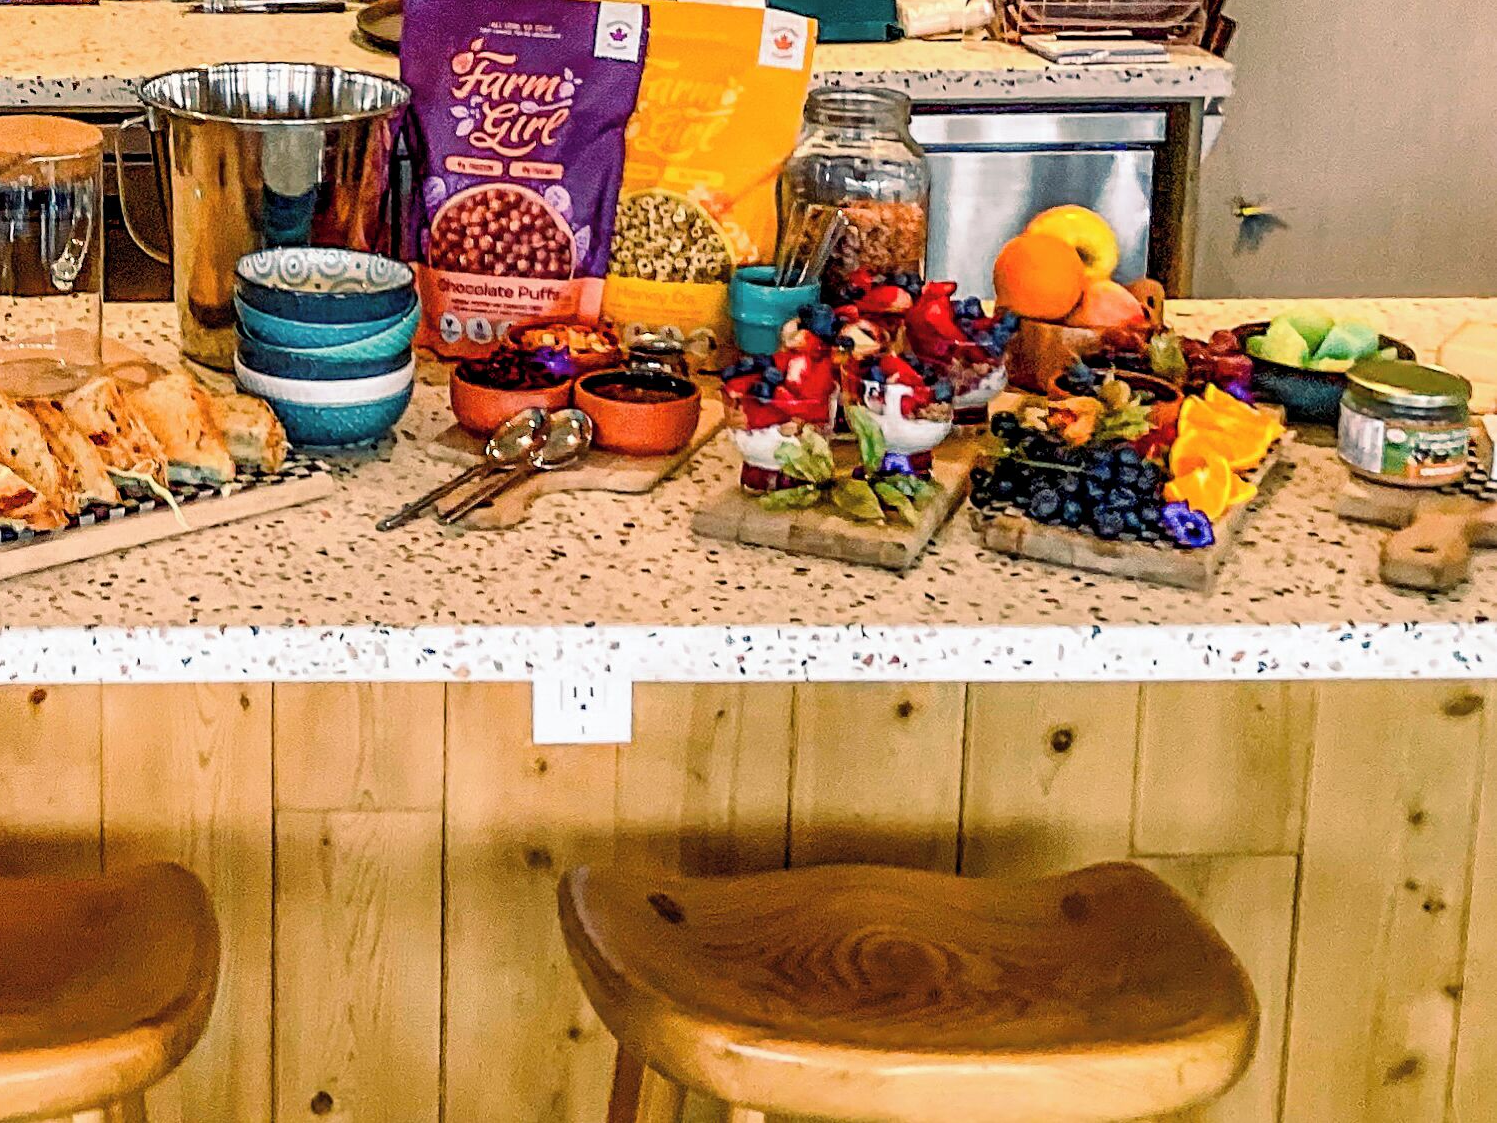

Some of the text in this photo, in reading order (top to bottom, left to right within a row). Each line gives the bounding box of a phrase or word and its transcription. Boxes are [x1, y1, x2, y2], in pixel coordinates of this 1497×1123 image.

[452, 50, 561, 103] Farm
[469, 100, 570, 158] Girl
[437, 278, 561, 301] Chocolate Puffs
